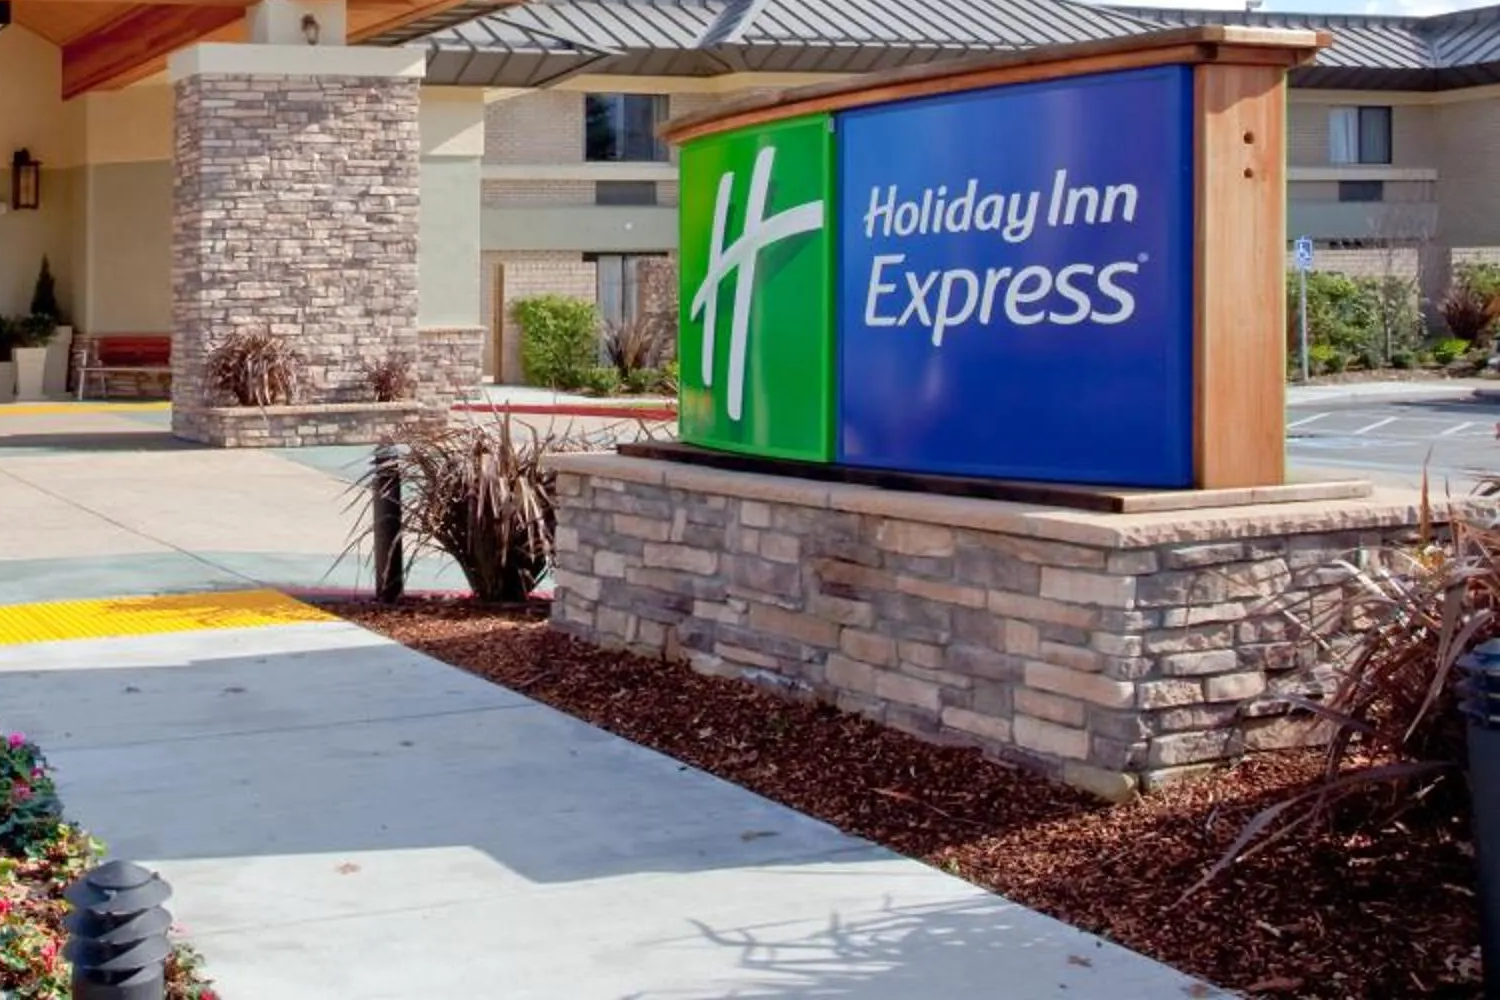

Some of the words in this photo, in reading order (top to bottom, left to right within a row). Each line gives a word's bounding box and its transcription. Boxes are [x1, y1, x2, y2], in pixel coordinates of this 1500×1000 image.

[864, 179, 1041, 243] Holiday
[1047, 168, 1139, 227] Inn
[691, 146, 824, 421] H
[865, 254, 1140, 347] Express
